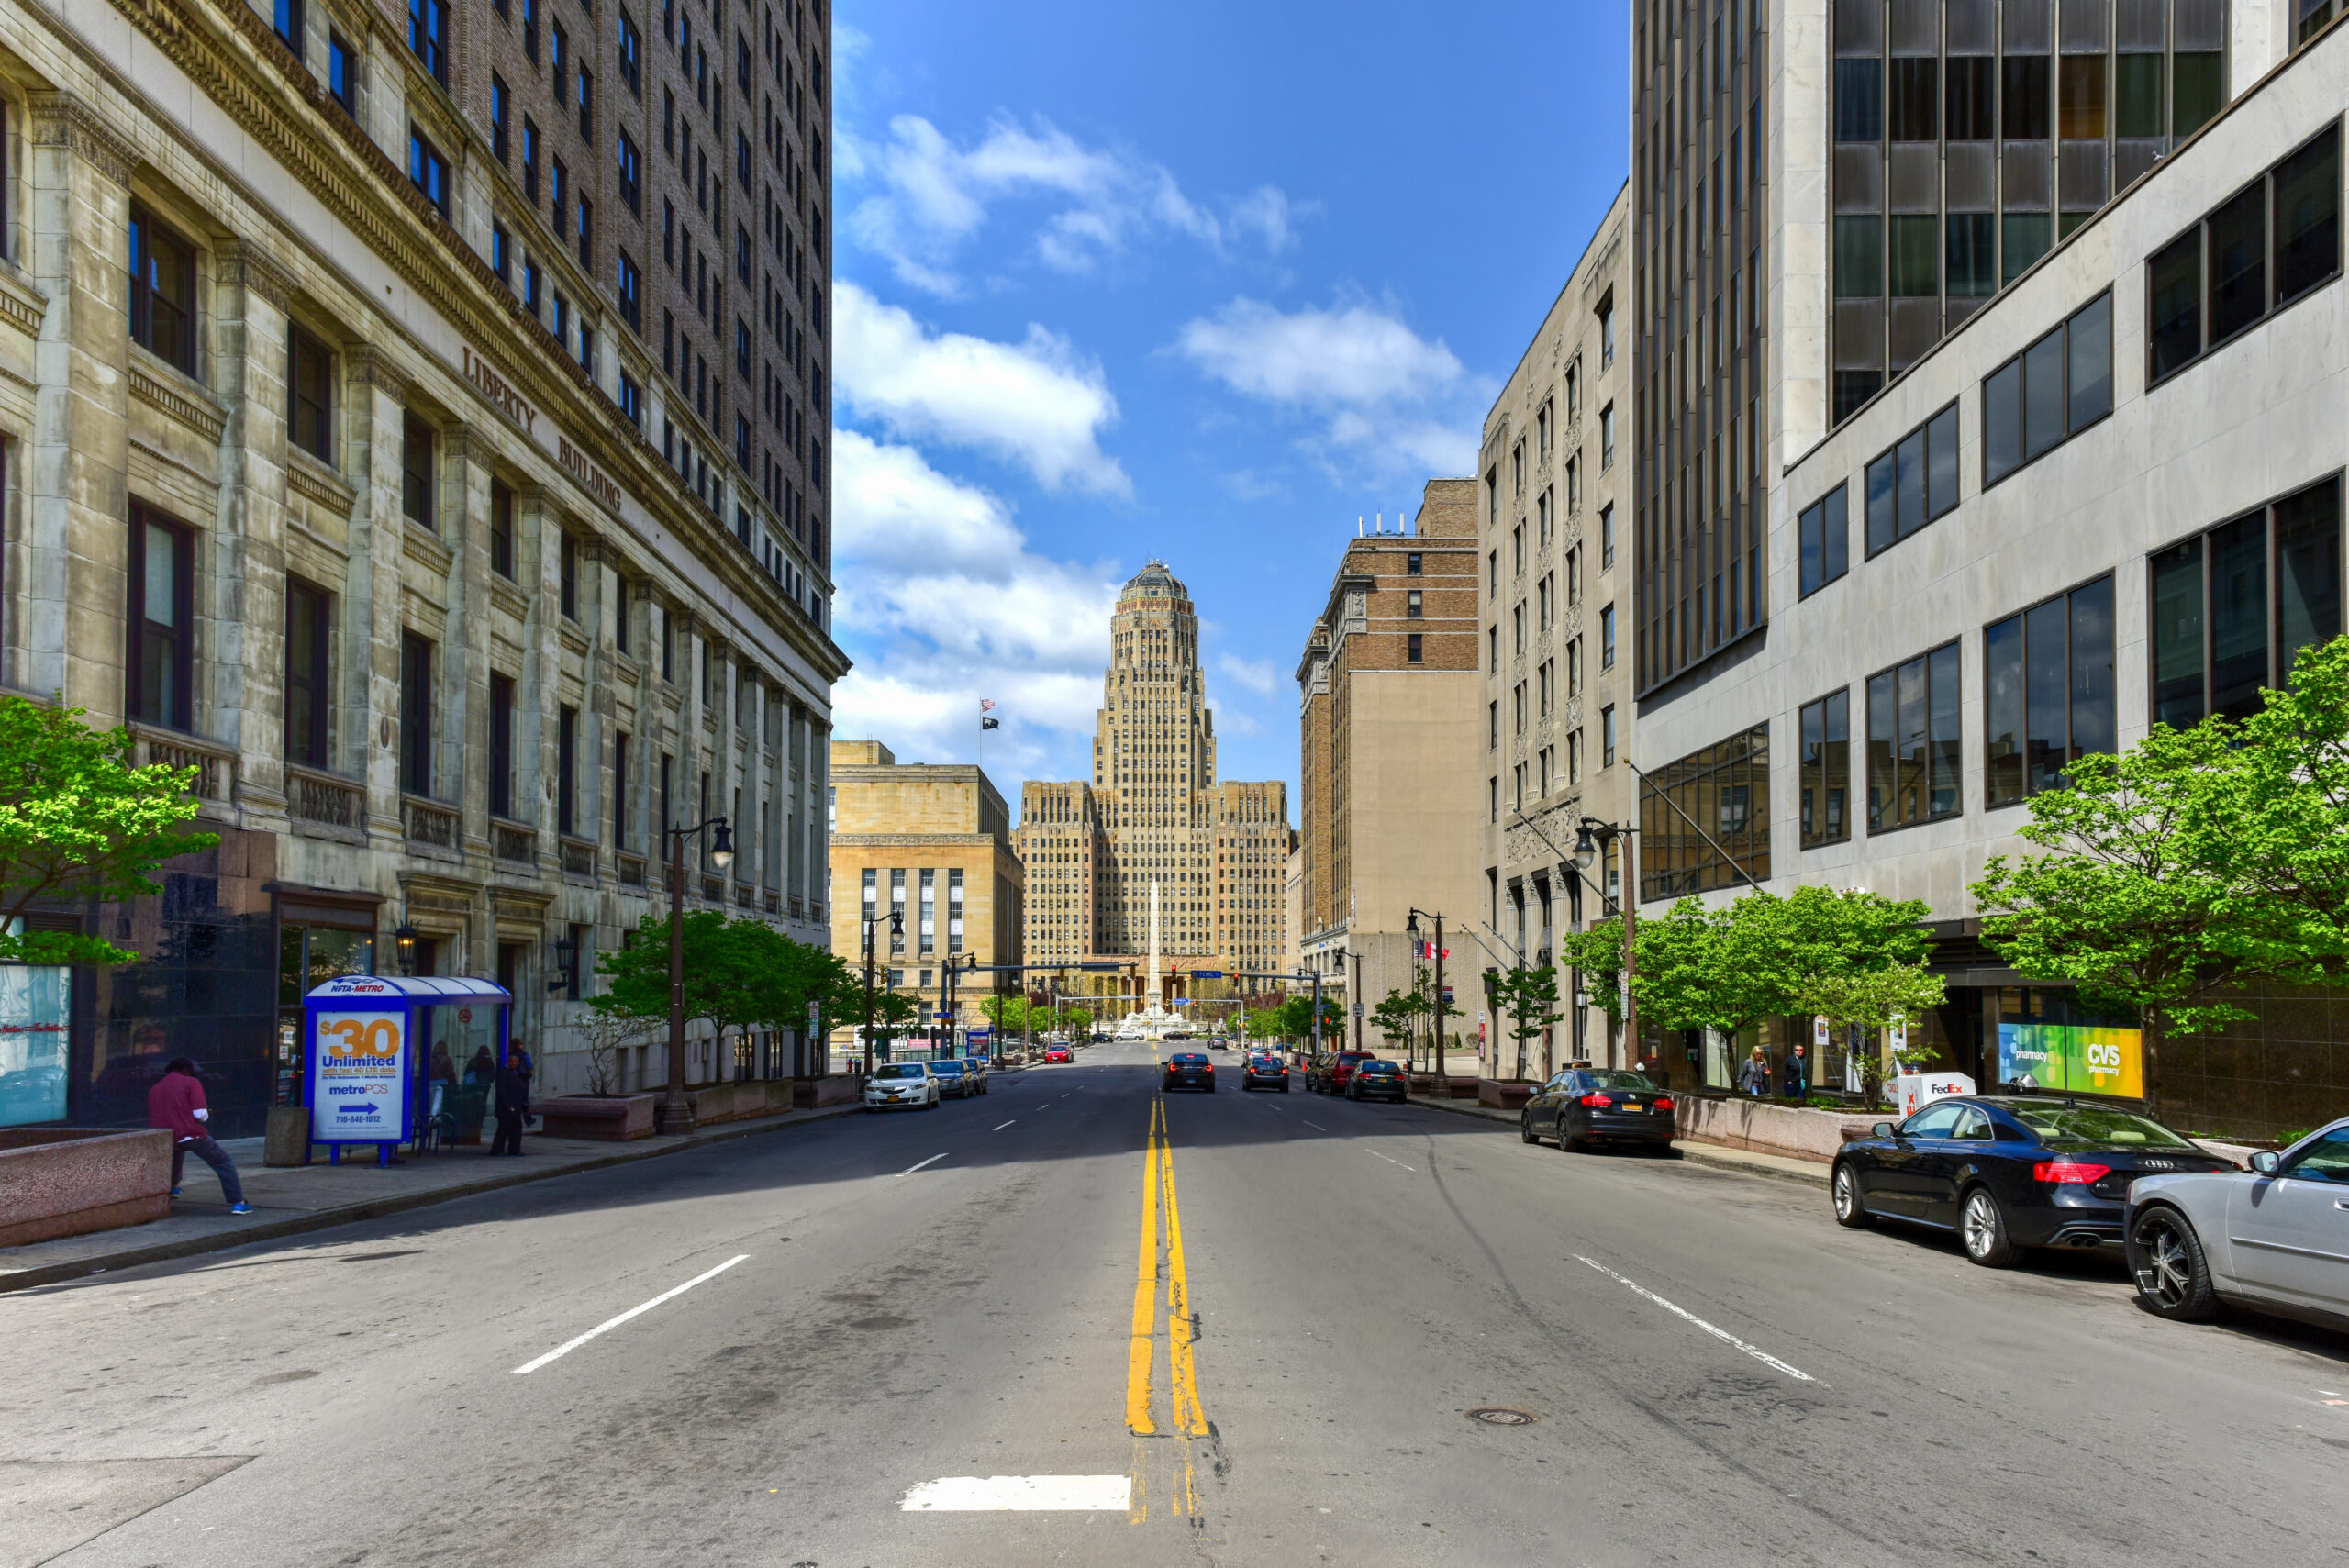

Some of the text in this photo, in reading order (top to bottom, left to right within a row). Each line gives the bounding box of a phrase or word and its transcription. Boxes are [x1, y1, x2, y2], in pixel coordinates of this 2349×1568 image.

[463, 347, 621, 513] LIBERTY BUILDING
[319, 1019, 400, 1058] $30
[2015, 1049, 2049, 1062] pharmacy
[2087, 1043, 2121, 1066] CVS
[322, 1055, 395, 1067] Unlimited
[2088, 1064, 2120, 1076] pharmacy
[329, 1084, 388, 1095] metroPCS
[1932, 1084, 1963, 1094] FedEx
